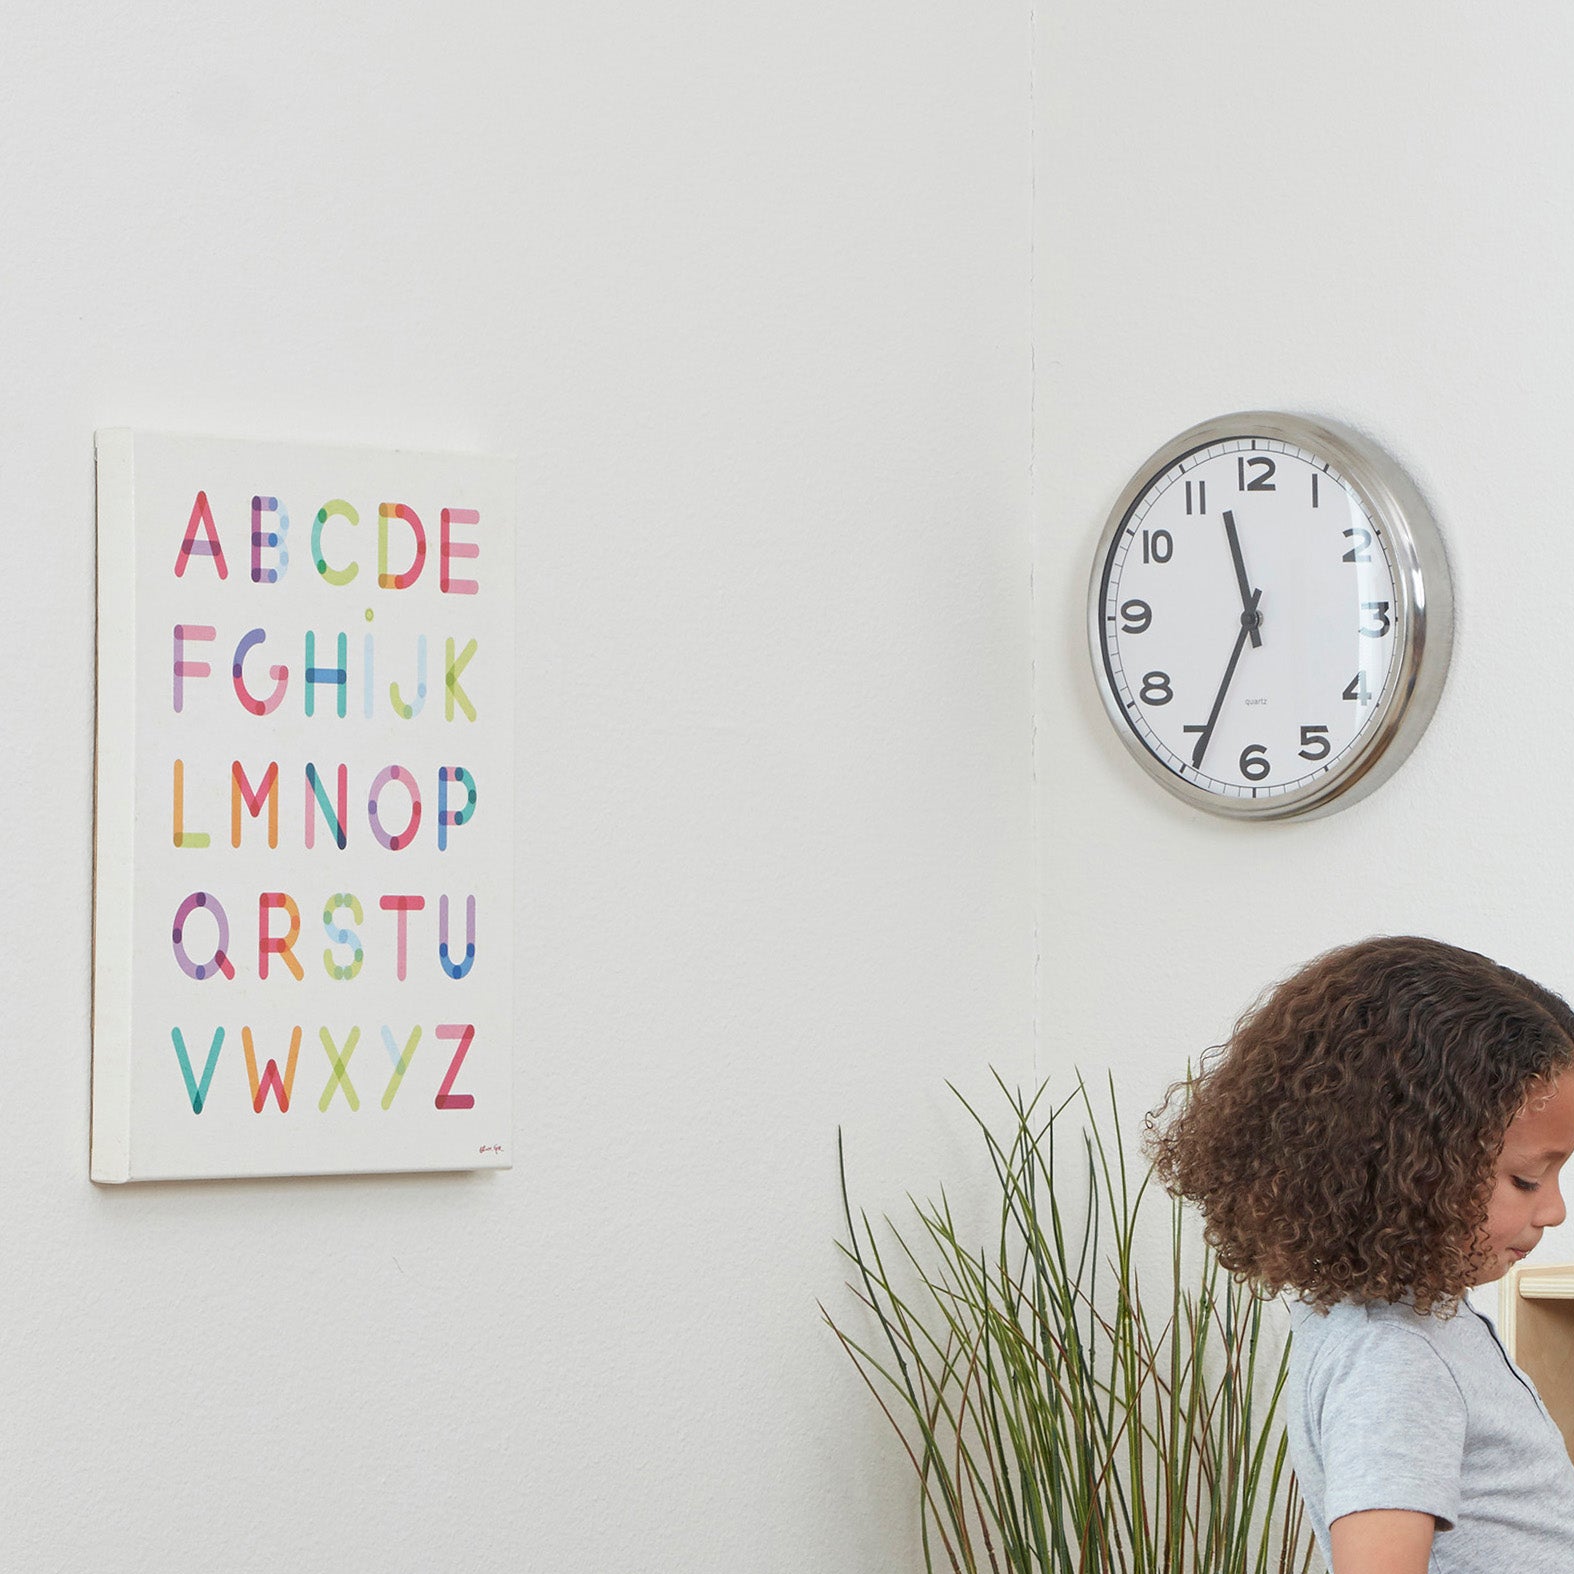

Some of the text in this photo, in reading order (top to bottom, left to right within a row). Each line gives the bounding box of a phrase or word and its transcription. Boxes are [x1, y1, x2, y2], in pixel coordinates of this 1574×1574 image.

[1238, 457, 1276, 491] 12
[1311, 474, 1319, 508] 1
[1185, 481, 1206, 515] 11
[1143, 529, 1174, 564] 10
[1342, 528, 1372, 563] 2
[1121, 599, 1152, 635] 9
[1358, 601, 1391, 638] 3
[1140, 671, 1173, 706] 8
[1342, 670, 1372, 706] 4
[1298, 726, 1331, 761] 5
[1240, 744, 1270, 781] 6
